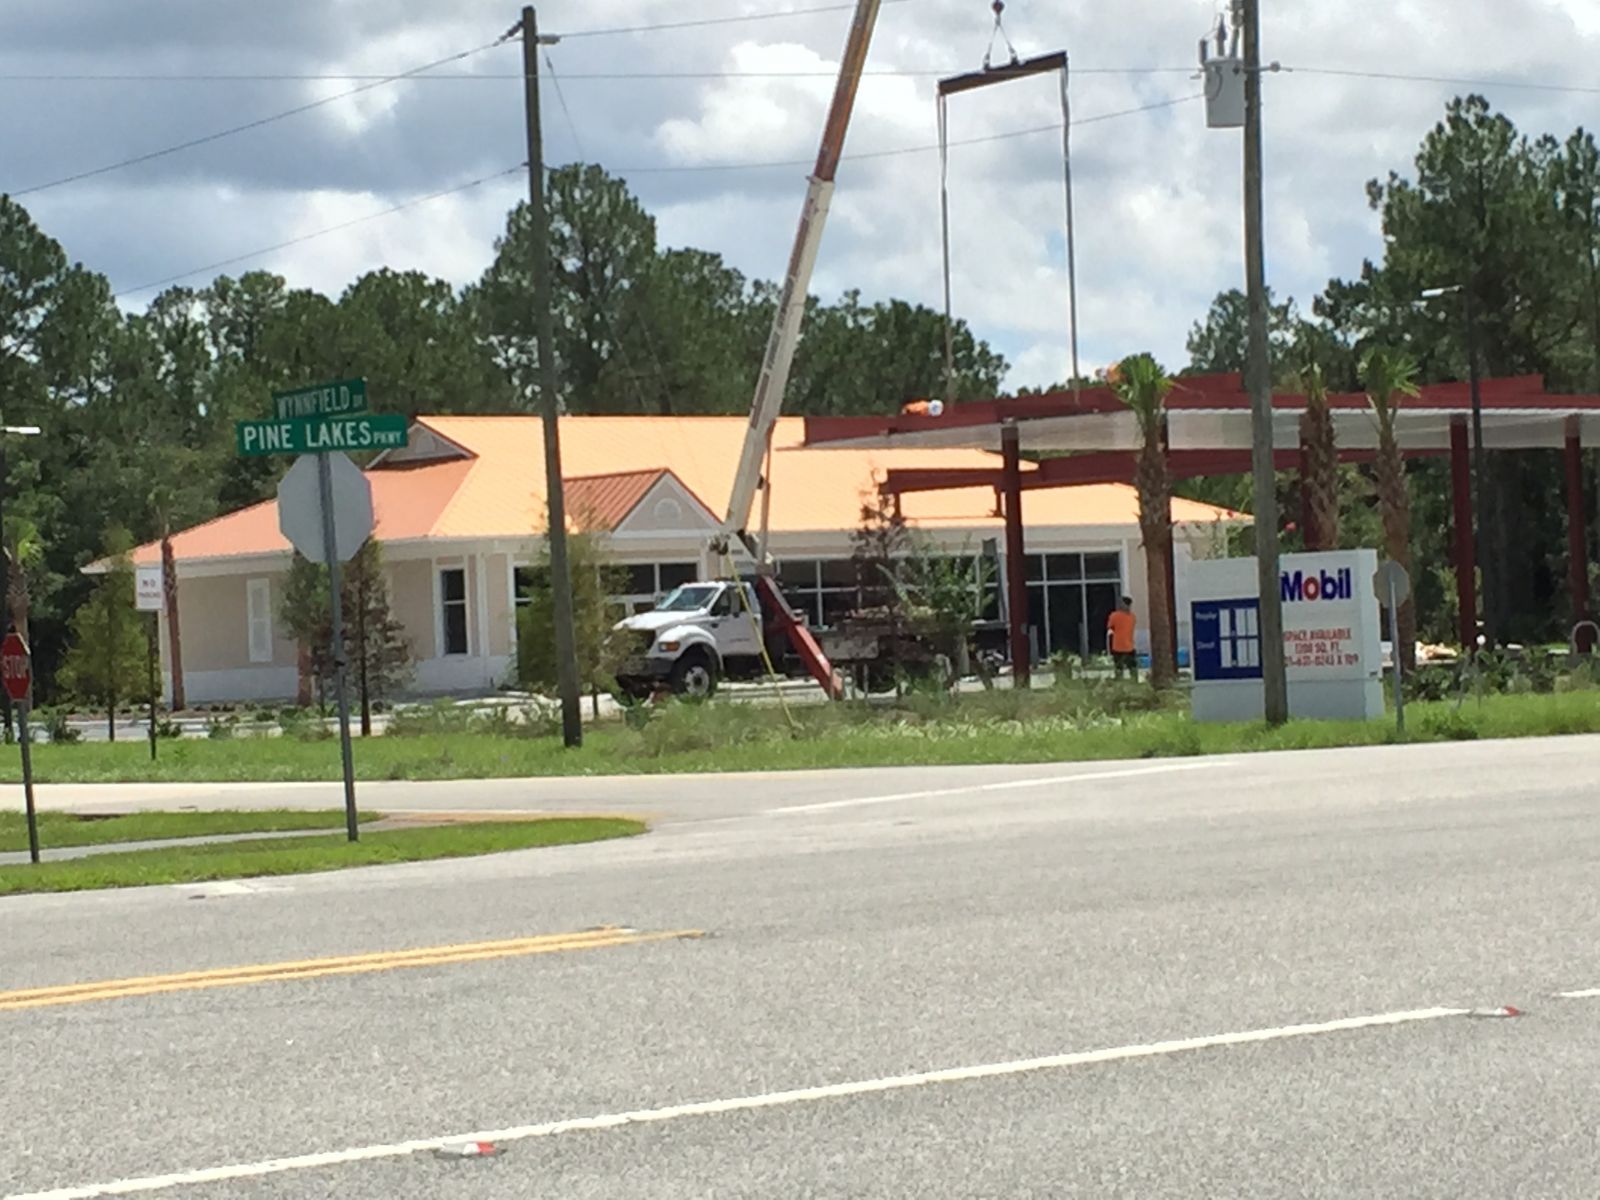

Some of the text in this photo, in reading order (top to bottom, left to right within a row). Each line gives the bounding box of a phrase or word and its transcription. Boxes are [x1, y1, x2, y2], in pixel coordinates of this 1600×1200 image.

[276, 385, 350, 420] WYNNFIELD
[243, 420, 403, 450] PINE LAKES PKWY
[1281, 567, 1351, 601] Mobil
[3, 654, 28, 679] STOP
